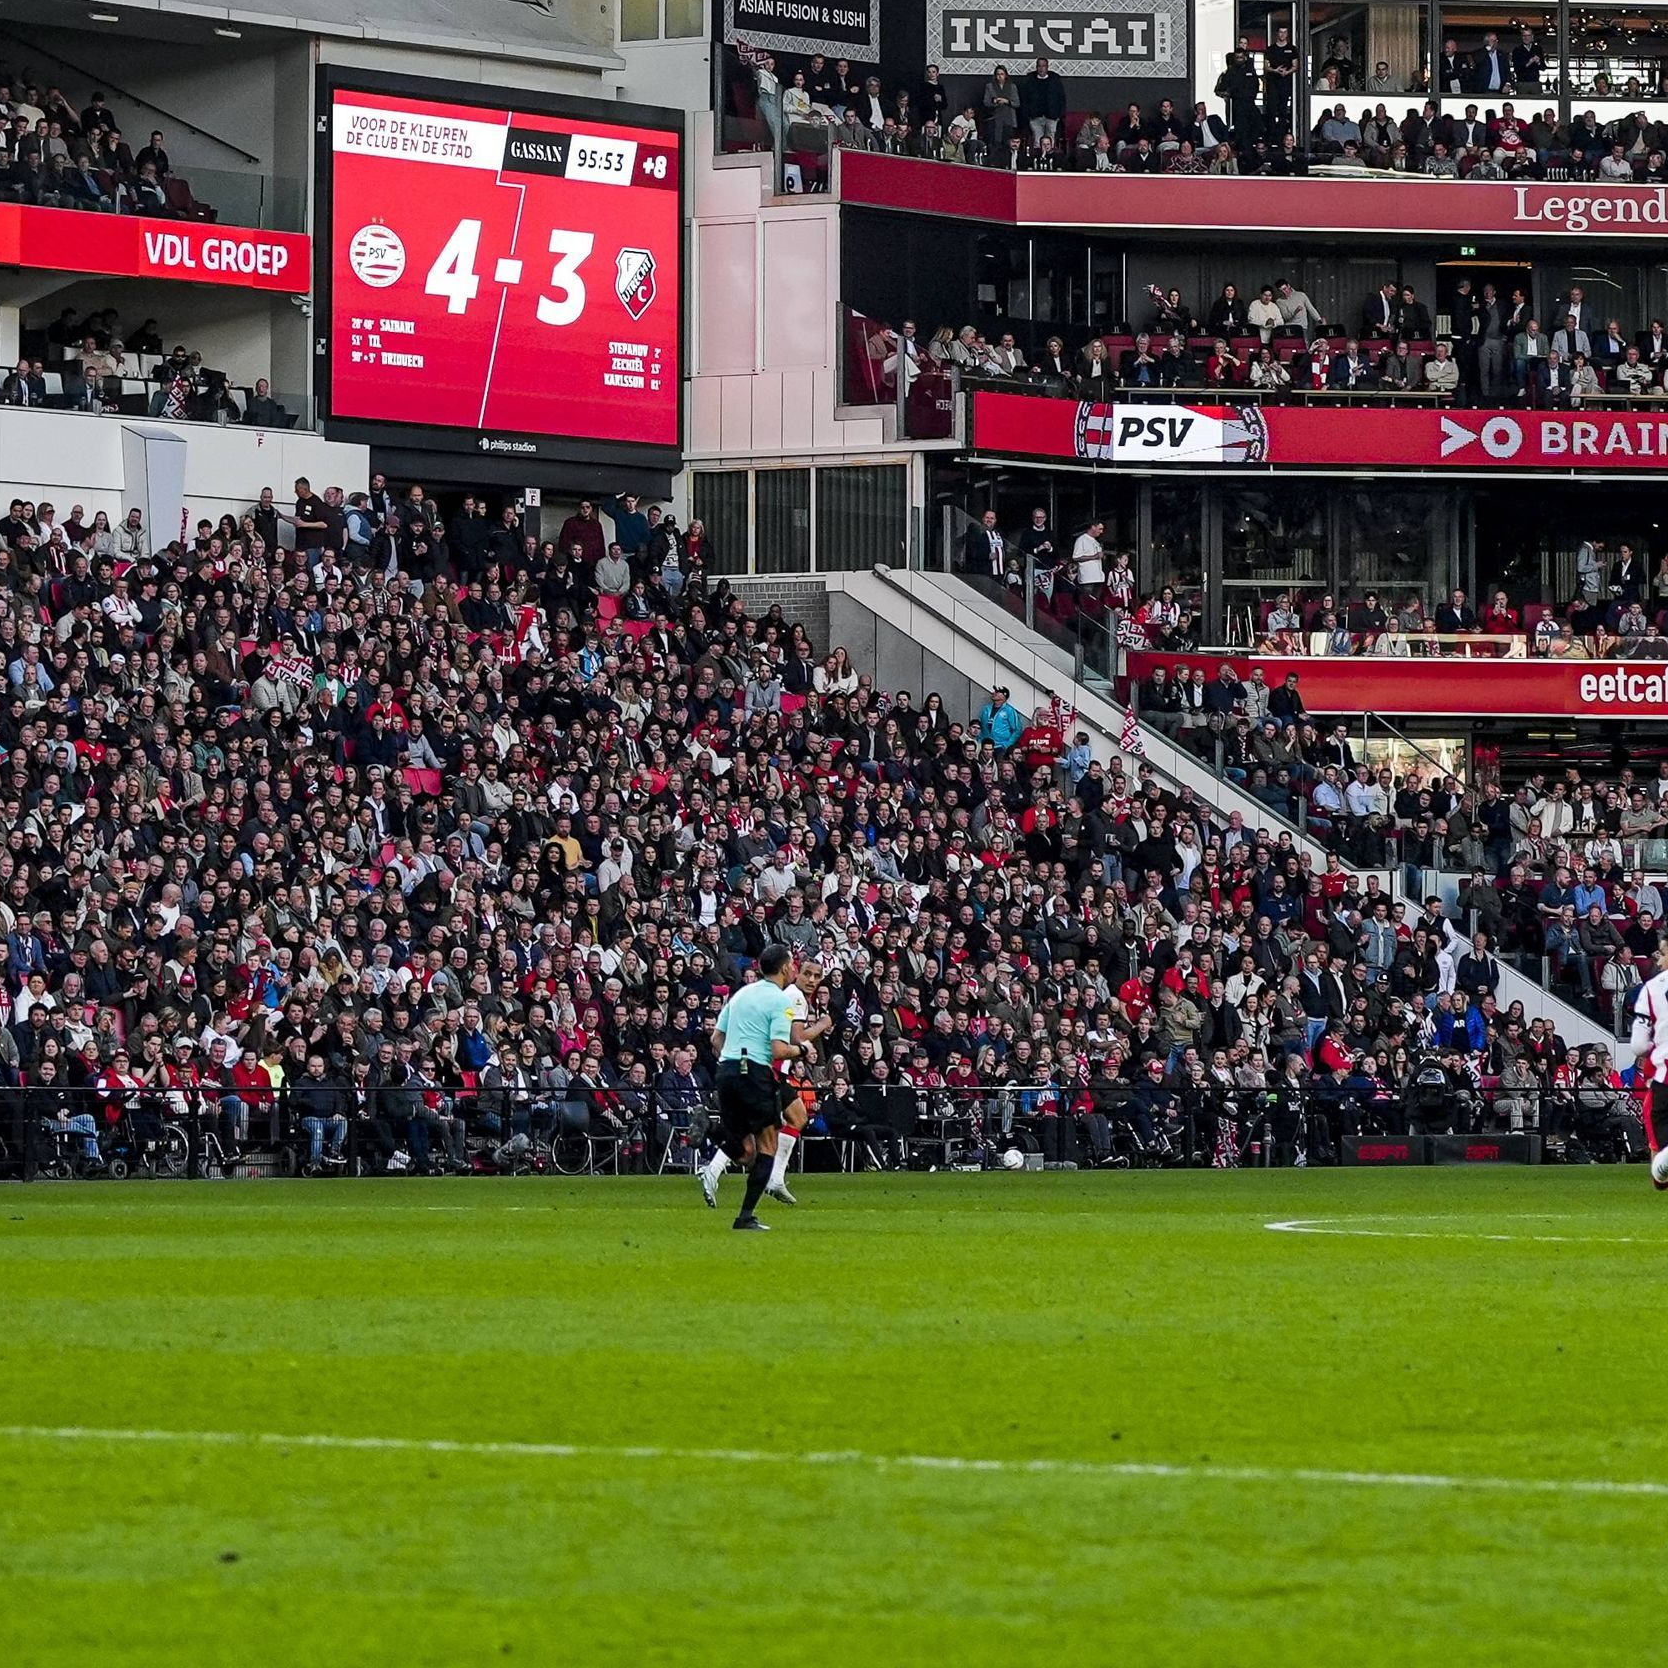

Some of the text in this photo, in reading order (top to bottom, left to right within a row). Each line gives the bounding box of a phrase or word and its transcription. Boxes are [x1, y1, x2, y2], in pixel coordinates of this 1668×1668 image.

[776, 0, 819, 23] FUSION
[821, 7, 830, 23] &
[832, 7, 866, 29] SUSHI
[950, 16, 1149, 55] IKIGAI
[351, 115, 469, 143] VOOR DE KLEUREN
[346, 131, 473, 159] DE CLUB EN DE STAD
[577, 148, 624, 173] 95:53
[642, 154, 668, 180] +8
[144, 231, 289, 278] VDL GROEP
[368, 245, 387, 260] PSV
[1117, 417, 1194, 448] PSV
[1357, 1144, 1409, 1161] ESPN
[1464, 1145, 1500, 1161] ESPN
